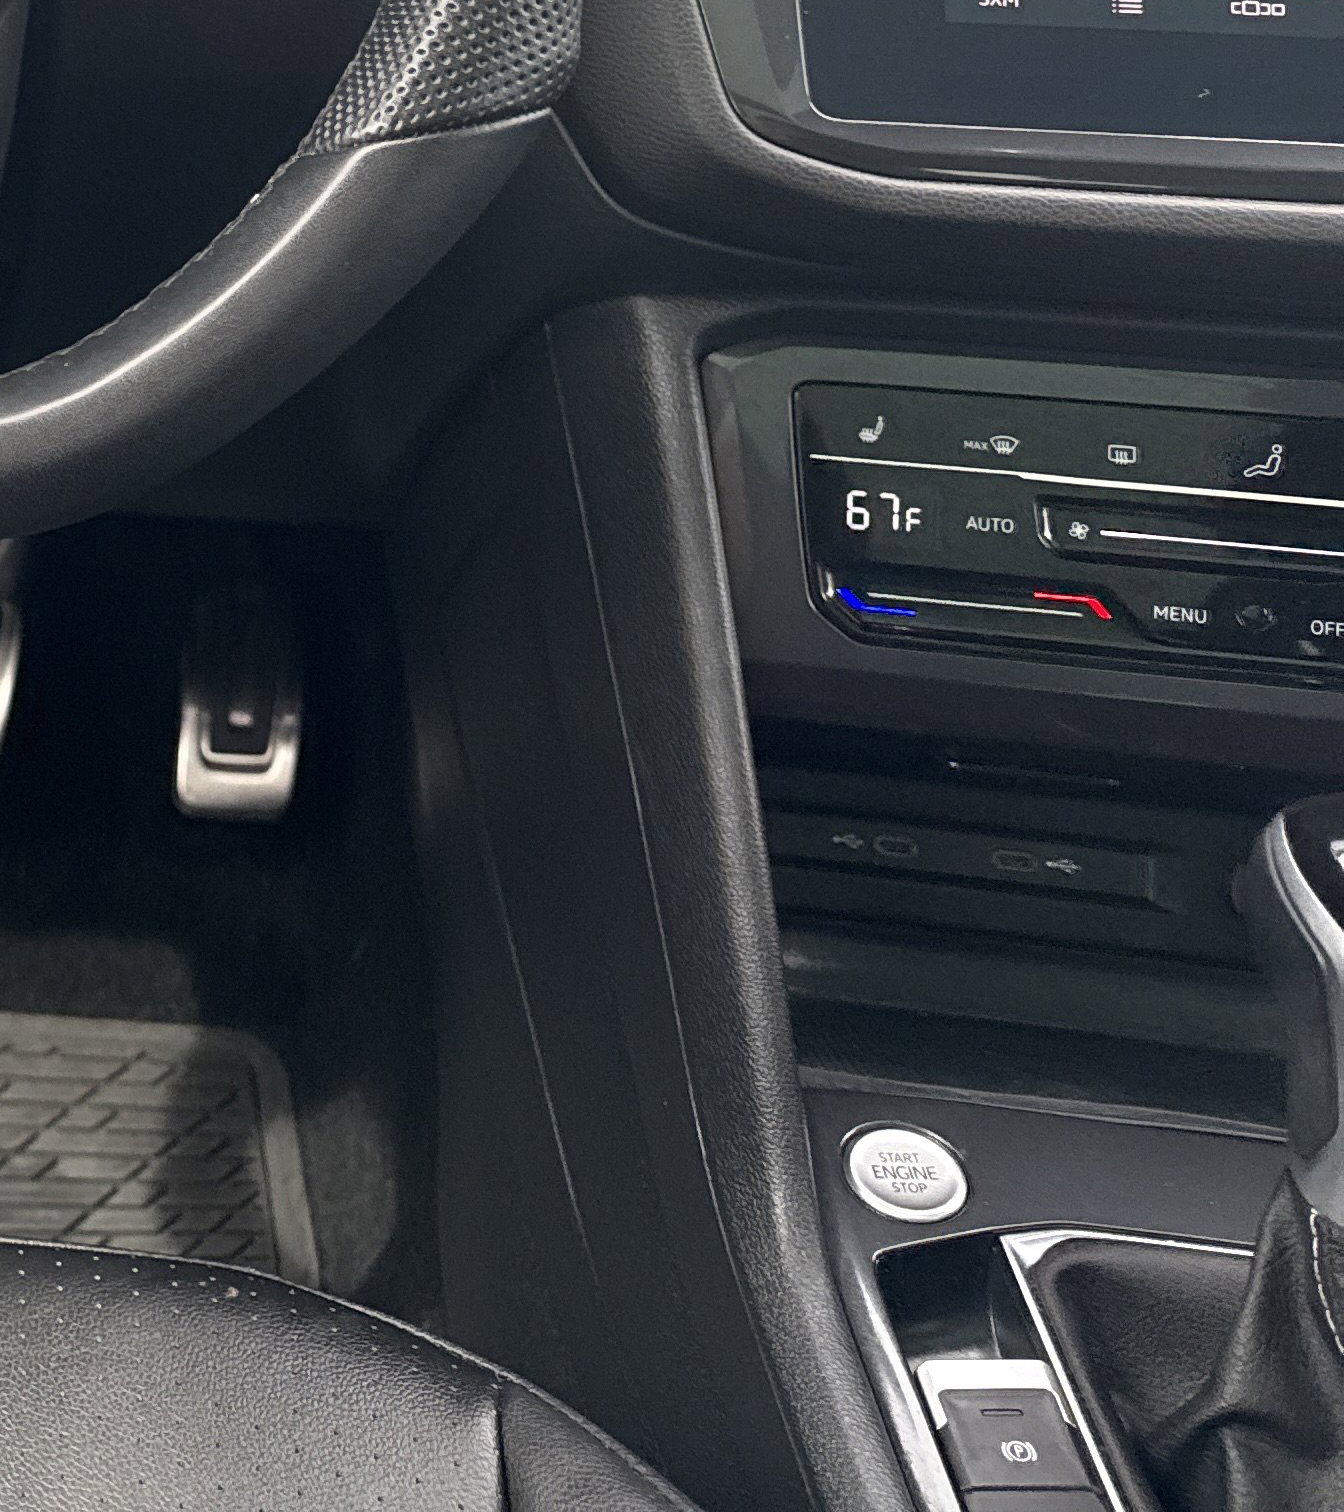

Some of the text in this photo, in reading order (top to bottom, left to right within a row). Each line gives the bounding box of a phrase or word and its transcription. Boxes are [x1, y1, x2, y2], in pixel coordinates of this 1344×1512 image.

[963, 439, 989, 451] MAX
[965, 515, 1015, 535] AUTO
[1152, 604, 1208, 625] MENU
[1310, 619, 1344, 637] OFF
[877, 1151, 919, 1164] START
[871, 1164, 939, 1180] ENGINE
[892, 1182, 928, 1194] STOP
